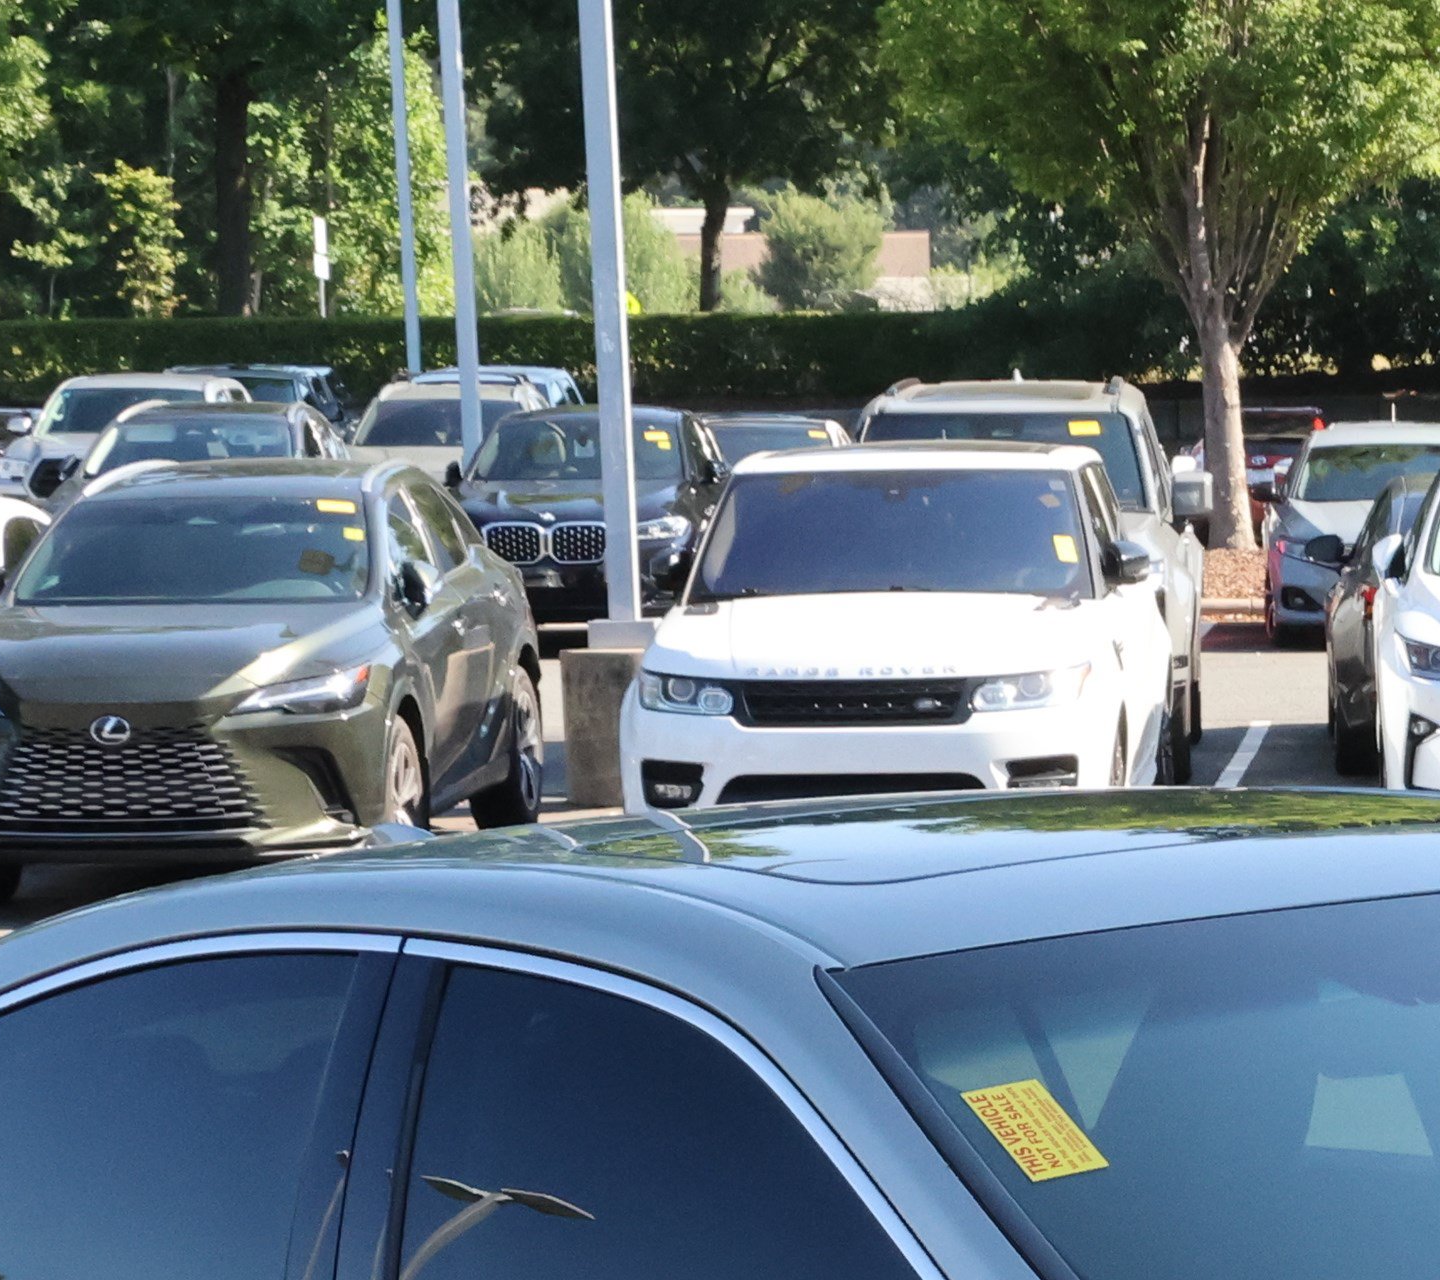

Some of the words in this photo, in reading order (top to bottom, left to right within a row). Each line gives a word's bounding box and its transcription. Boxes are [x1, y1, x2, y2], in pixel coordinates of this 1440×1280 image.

[859, 665, 958, 676] ROVER
[992, 1092, 1023, 1120] SALE
[968, 1093, 1021, 1147] VEHICLE
[1017, 1122, 1044, 1145] FOR
[1014, 1147, 1048, 1176] THIS
[1036, 1146, 1063, 1169] NOT
